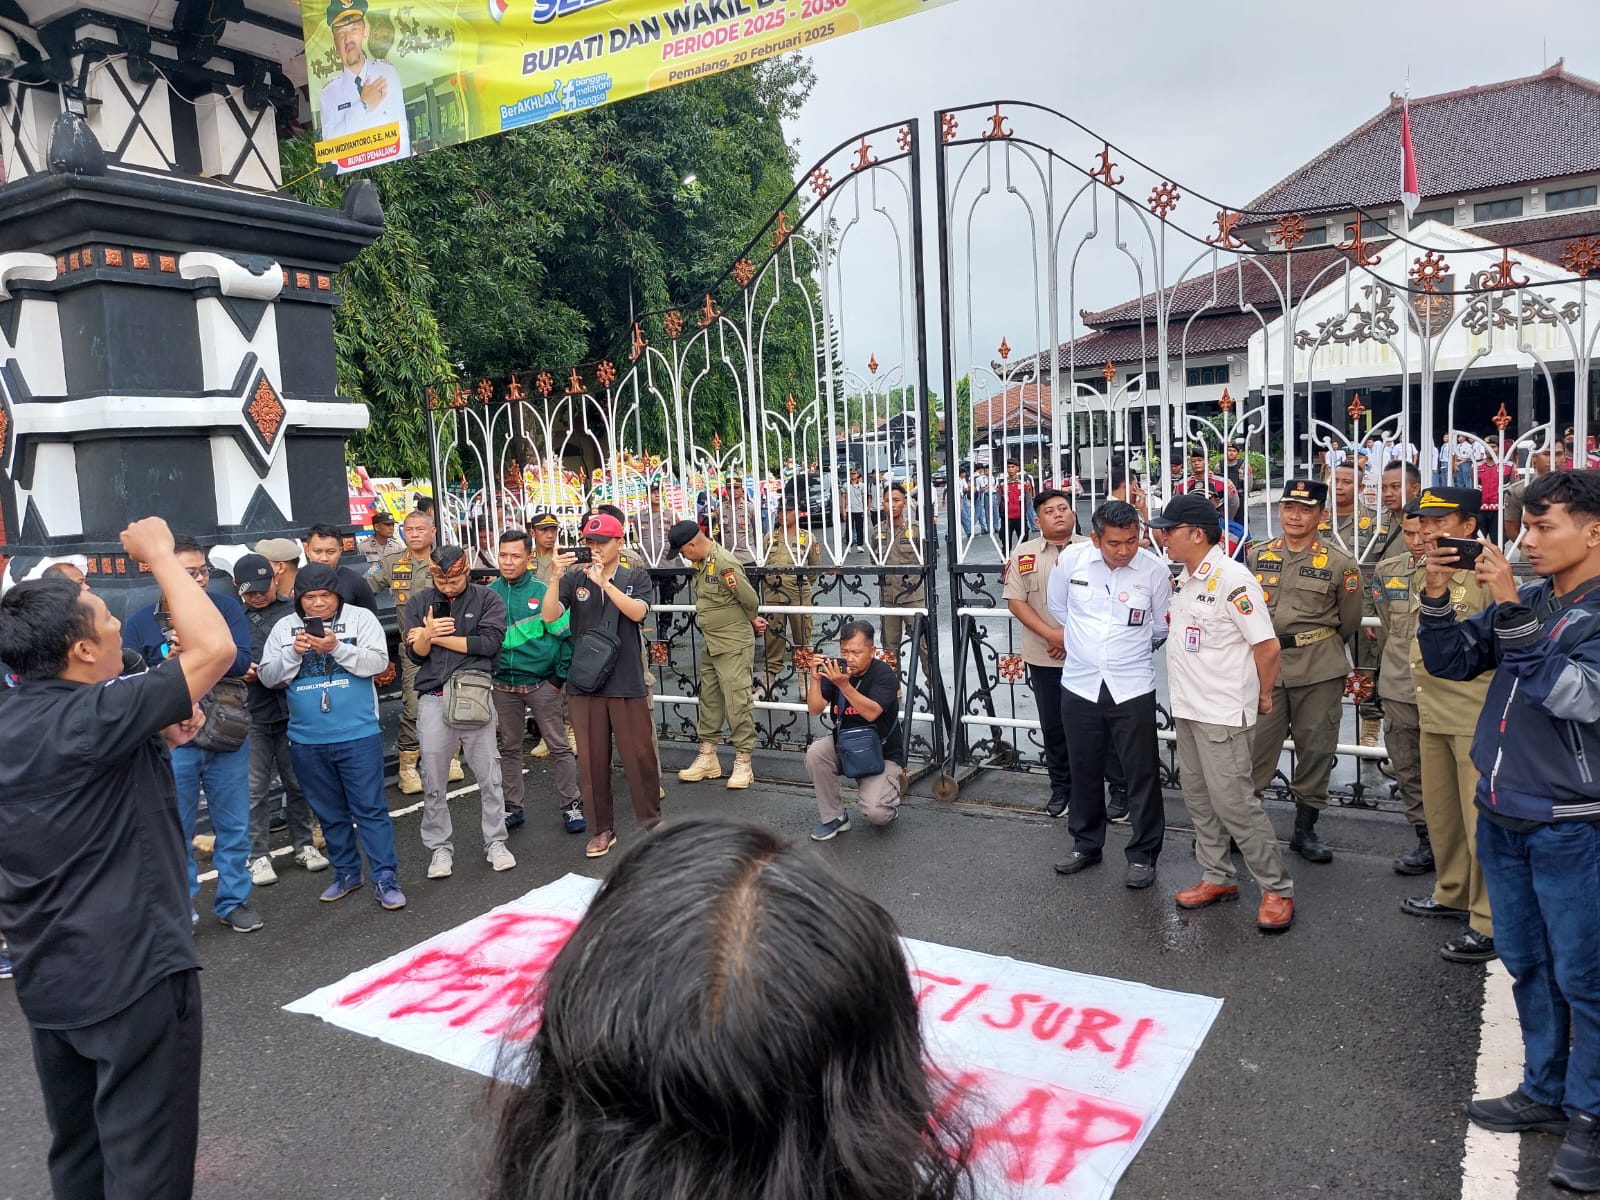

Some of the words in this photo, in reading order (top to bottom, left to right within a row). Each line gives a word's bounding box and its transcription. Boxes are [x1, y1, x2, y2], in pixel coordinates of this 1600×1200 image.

[522, 34, 603, 74] BUPATI
[608, 16, 661, 53] DAN
[663, 0, 750, 35] WAKIL
[662, 22, 739, 60] PERIODE
[743, 8, 785, 37] 2025
[669, 55, 730, 82] Pemalang,
[733, 51, 747, 63] 20
[750, 32, 801, 58] Februari
[804, 23, 835, 42] 2025
[575, 80, 612, 97] melayani
[500, 91, 558, 119] BerAKHLAK
[577, 93, 606, 107] bangsa
[317, 146, 334, 158] ANOM
[347, 153, 367, 166] BUPATI
[367, 145, 397, 160] PEMALANG
[1301, 568, 1318, 577] POL
[1319, 570, 1331, 578] PP
[1206, 595, 1216, 604] PP
[980, 993, 1155, 1071] SURI
